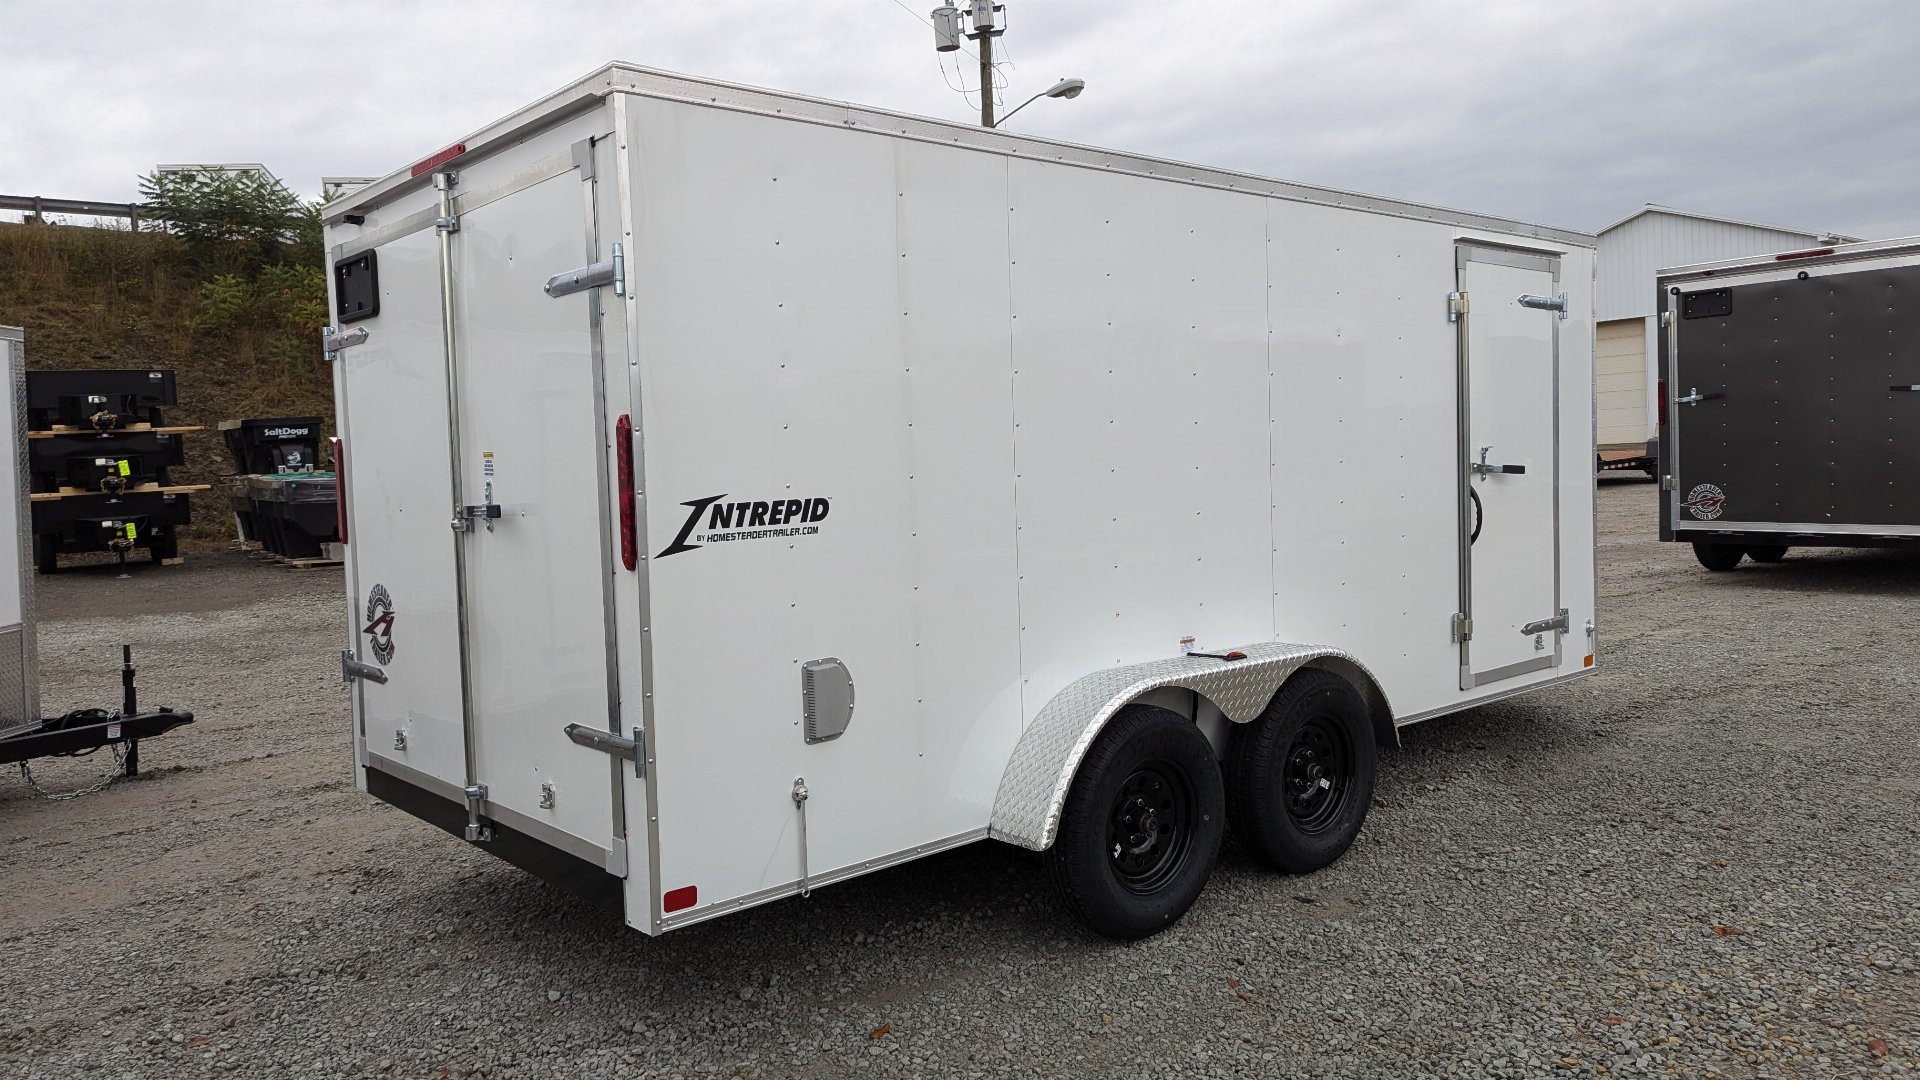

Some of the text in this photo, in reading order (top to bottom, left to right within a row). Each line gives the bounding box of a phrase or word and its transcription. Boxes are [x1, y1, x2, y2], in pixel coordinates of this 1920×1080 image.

[264, 427, 309, 436] SaltDogg
[653, 494, 829, 559] INTREPID
[697, 526, 819, 542] BY HOMESTEADERTRAILER.COM
